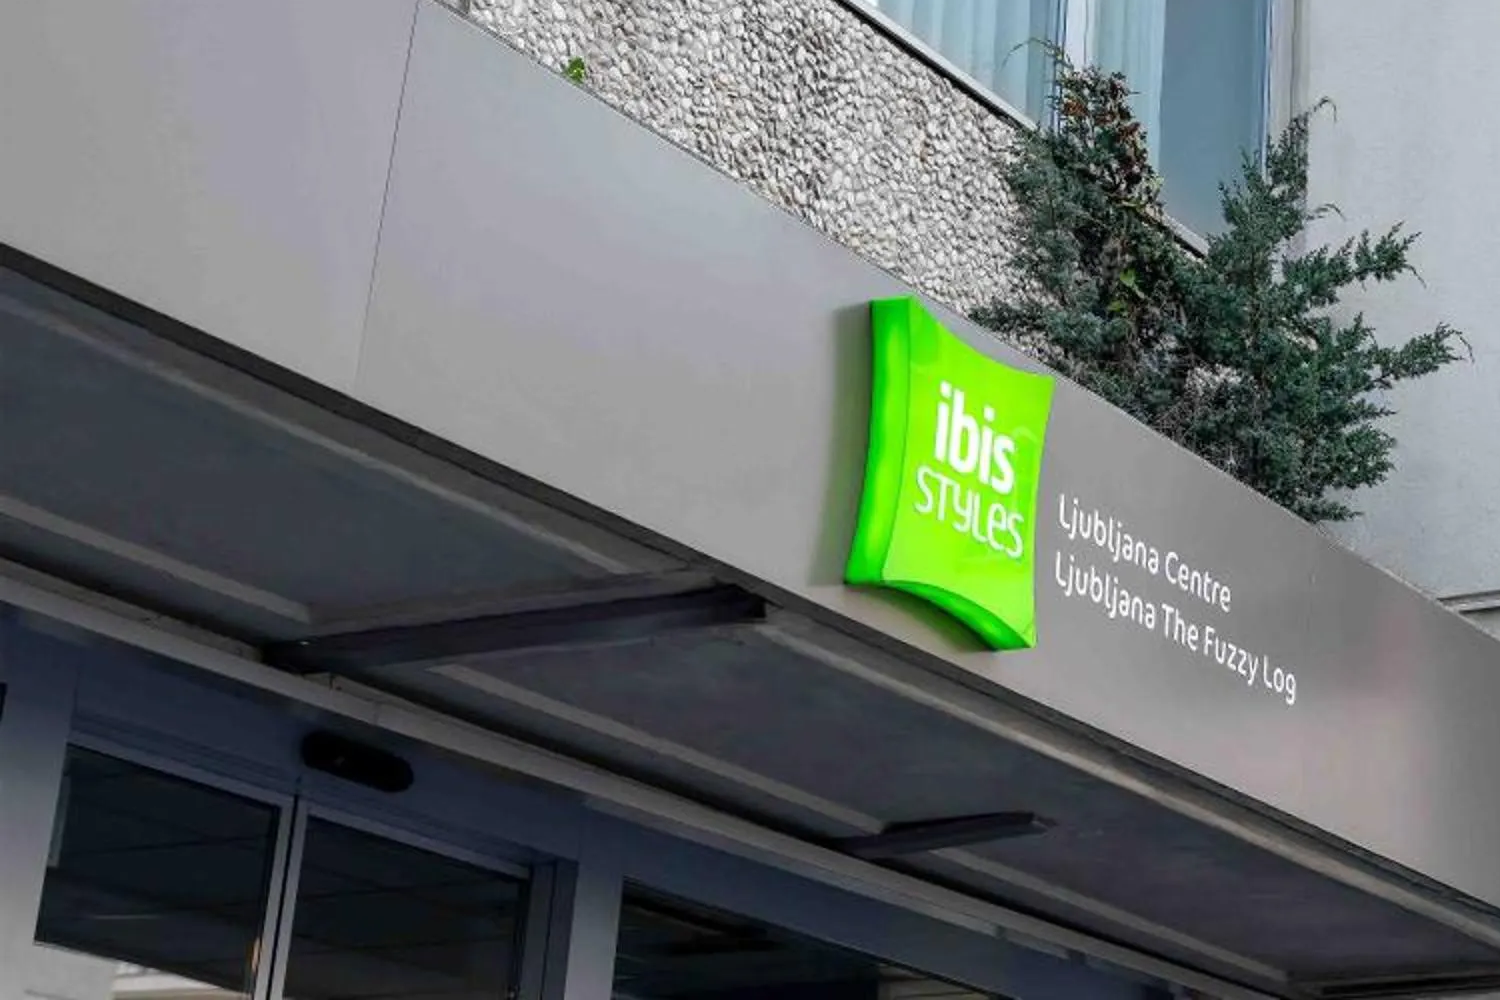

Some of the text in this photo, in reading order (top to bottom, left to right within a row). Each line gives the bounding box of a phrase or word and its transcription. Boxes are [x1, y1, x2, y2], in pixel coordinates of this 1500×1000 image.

[935, 380, 1015, 494] ibis
[1059, 493, 1232, 613] Ljubljana Centre
[1055, 551, 1297, 705] Ljubljana The Fuzzy Log
